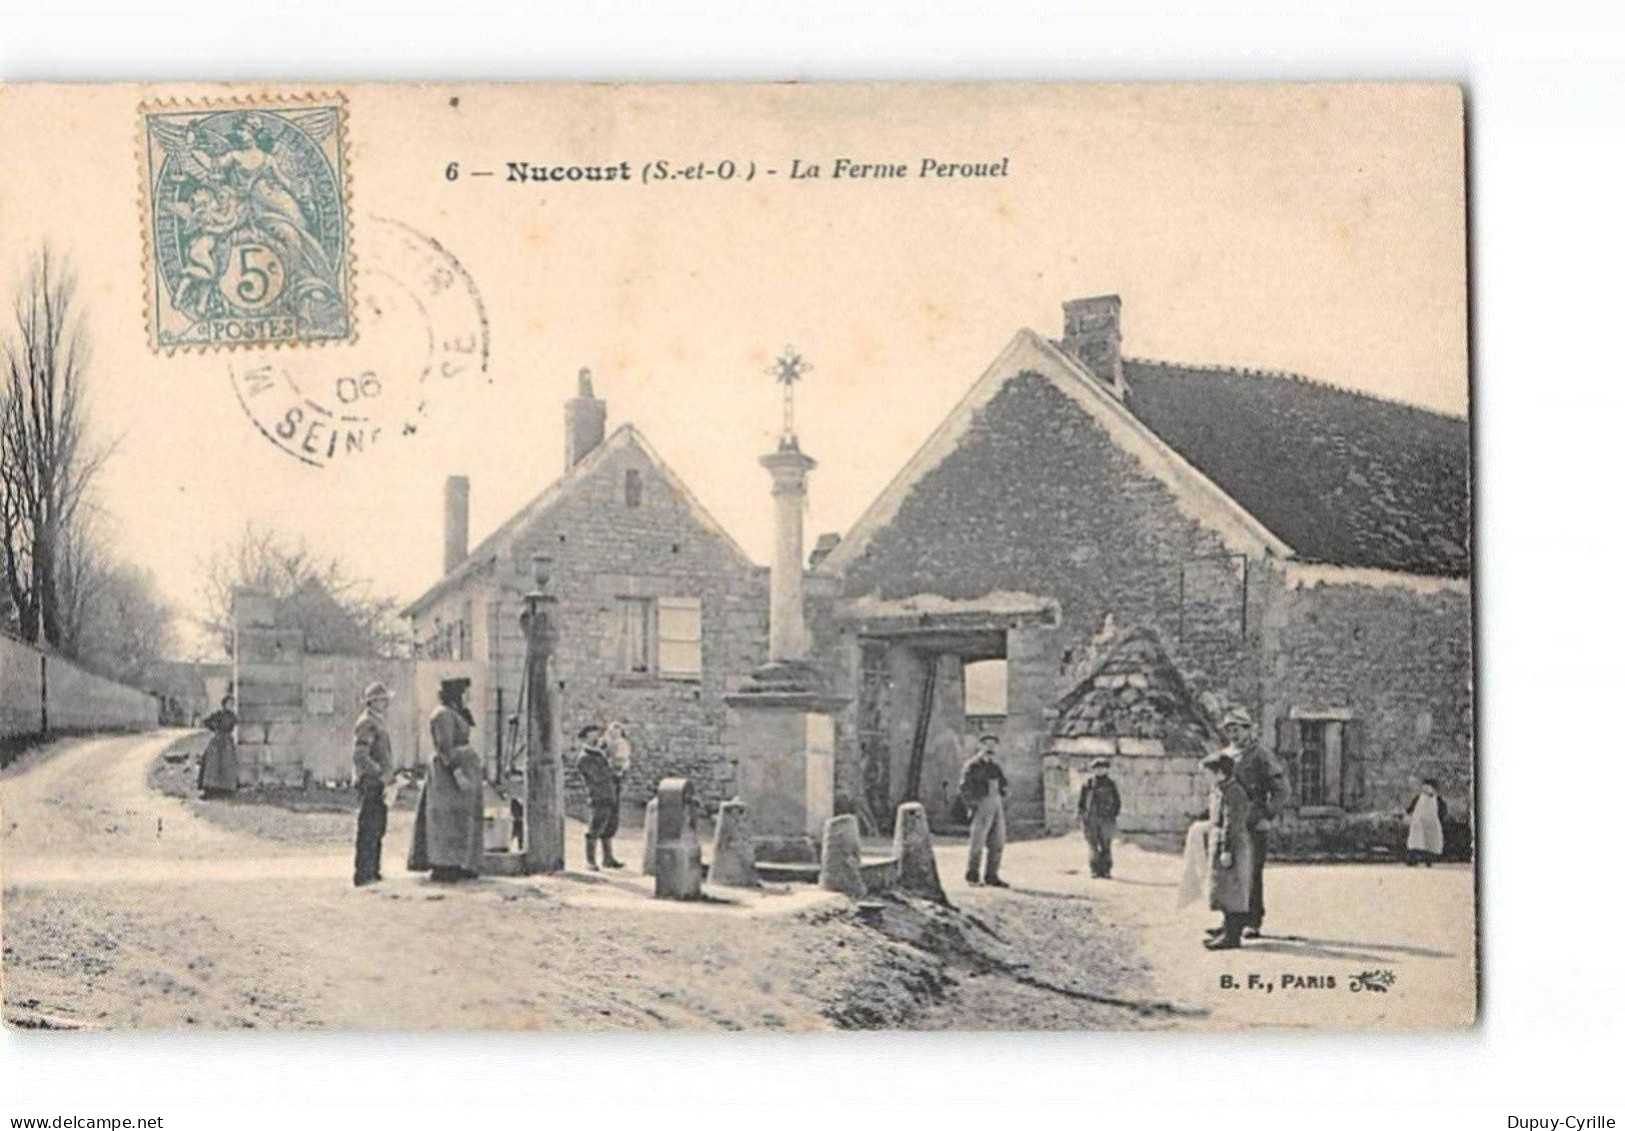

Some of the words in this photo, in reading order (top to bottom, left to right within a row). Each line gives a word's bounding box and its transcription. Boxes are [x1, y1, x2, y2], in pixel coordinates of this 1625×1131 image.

[445, 161, 459, 182] 6
[506, 161, 631, 183] Nucourt
[790, 159, 820, 180] La
[831, 158, 908, 179] Ferme
[919, 157, 1009, 178] Perouel
[214, 317, 295, 340] POSTES
[335, 370, 383, 404] 06
[1219, 973, 1241, 990] B.
[1247, 973, 1274, 995] F.,
[1280, 973, 1338, 990] PARIS
